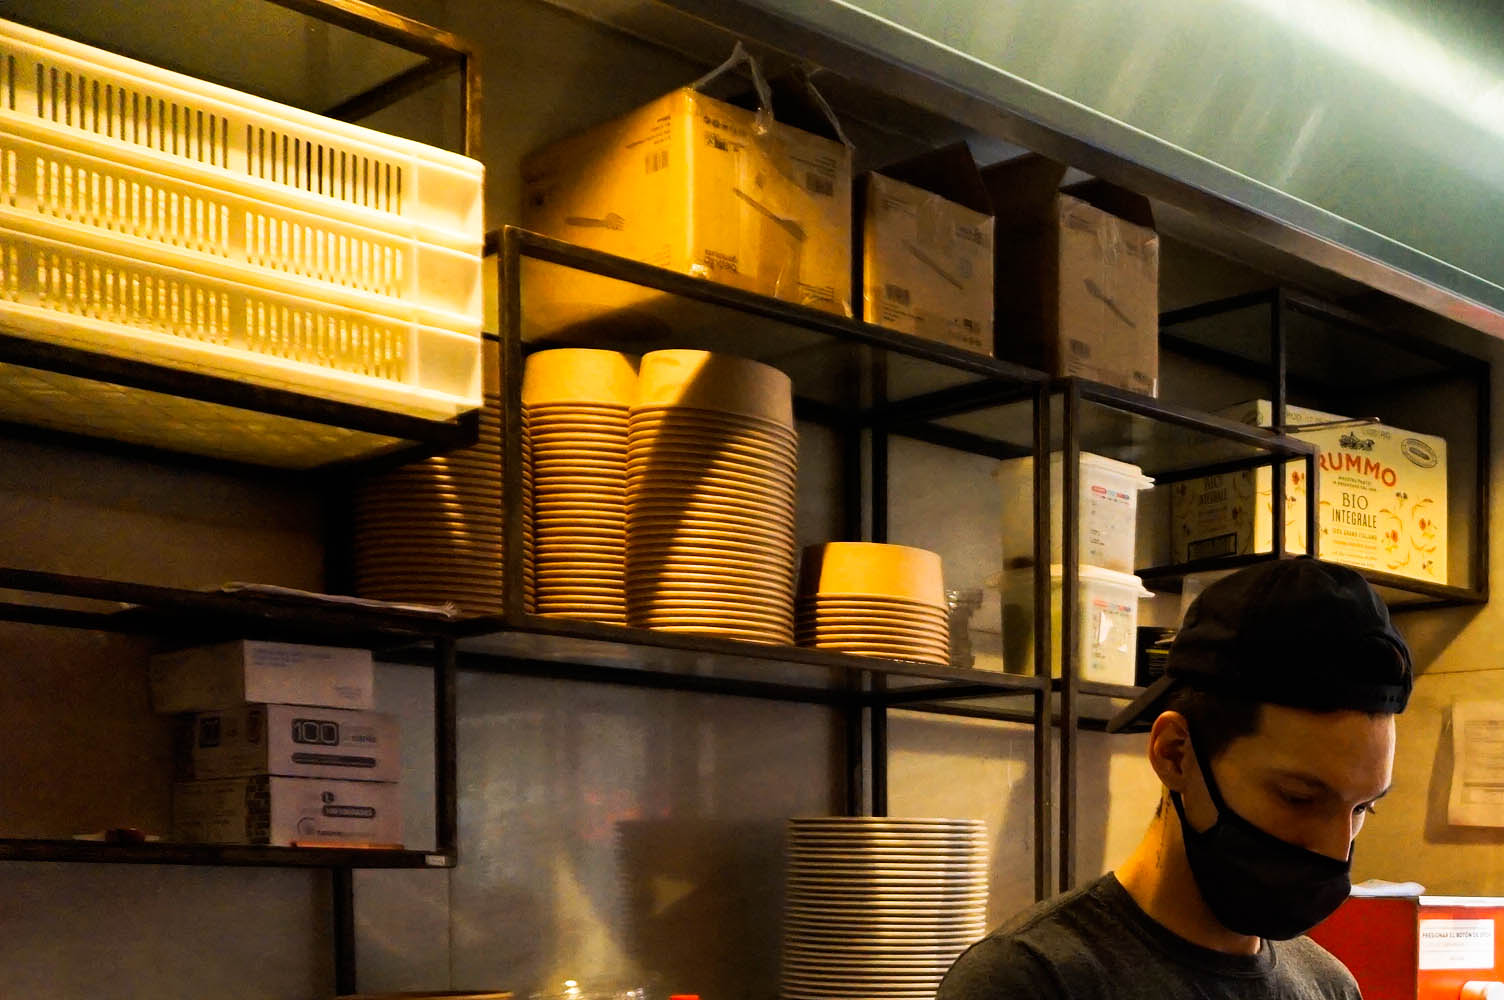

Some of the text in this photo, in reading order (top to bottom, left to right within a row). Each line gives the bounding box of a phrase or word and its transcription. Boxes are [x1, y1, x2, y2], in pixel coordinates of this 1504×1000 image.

[1342, 492, 1369, 511] BIO
[1332, 508, 1377, 529] INTEGRALE
[294, 720, 337, 744] 100
